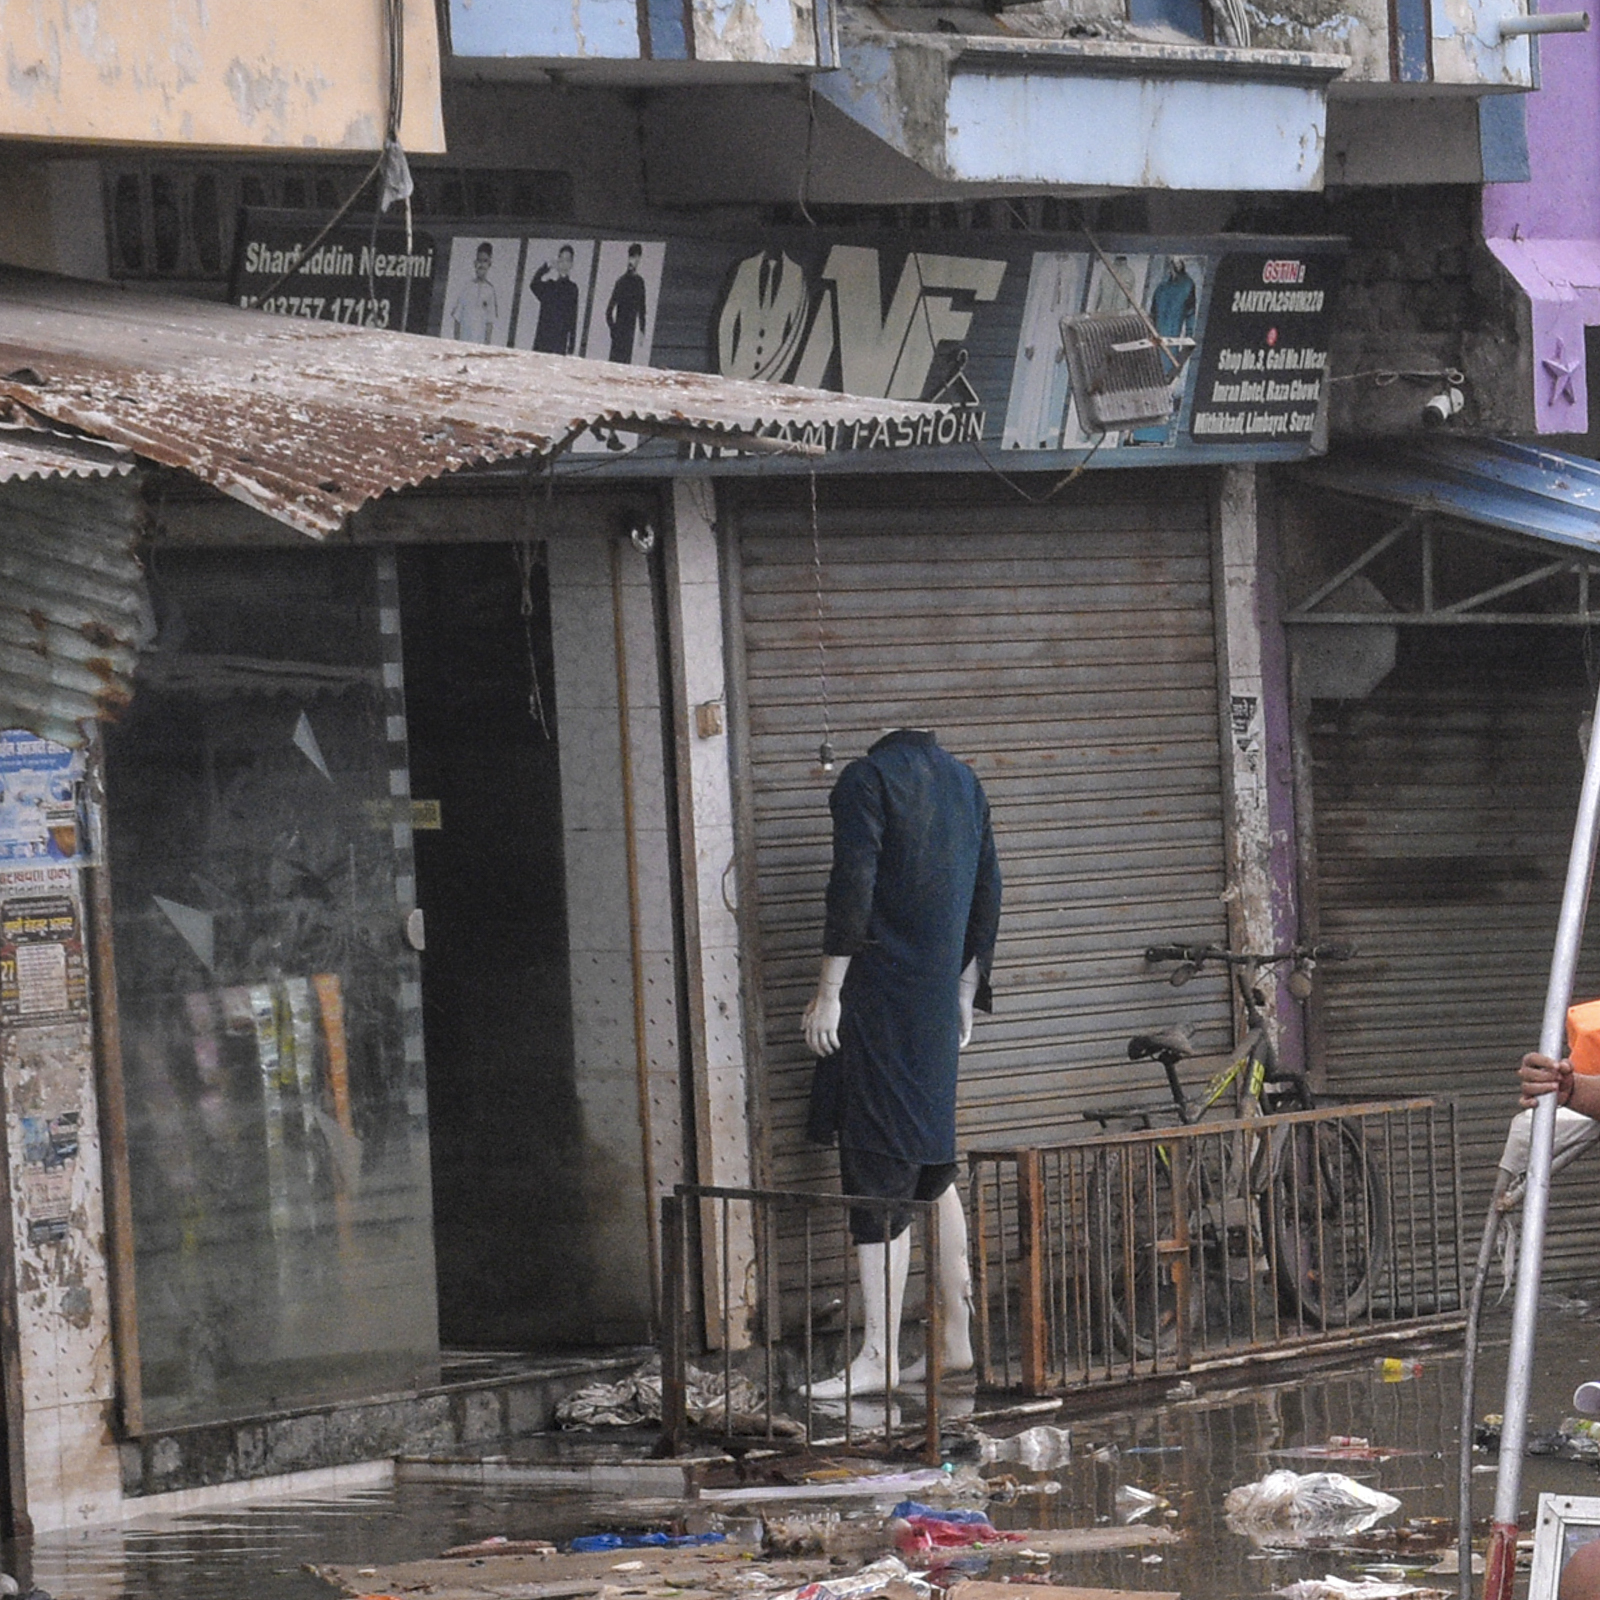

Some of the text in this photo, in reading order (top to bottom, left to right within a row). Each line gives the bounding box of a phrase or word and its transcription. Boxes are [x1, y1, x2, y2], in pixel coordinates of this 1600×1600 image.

[359, 246, 433, 278] Nezami
[1218, 349, 1242, 374] Shop
[1212, 380, 1241, 402] Imran
[1266, 380, 1290, 402] Raza
[689, 420, 839, 460] NAMI
